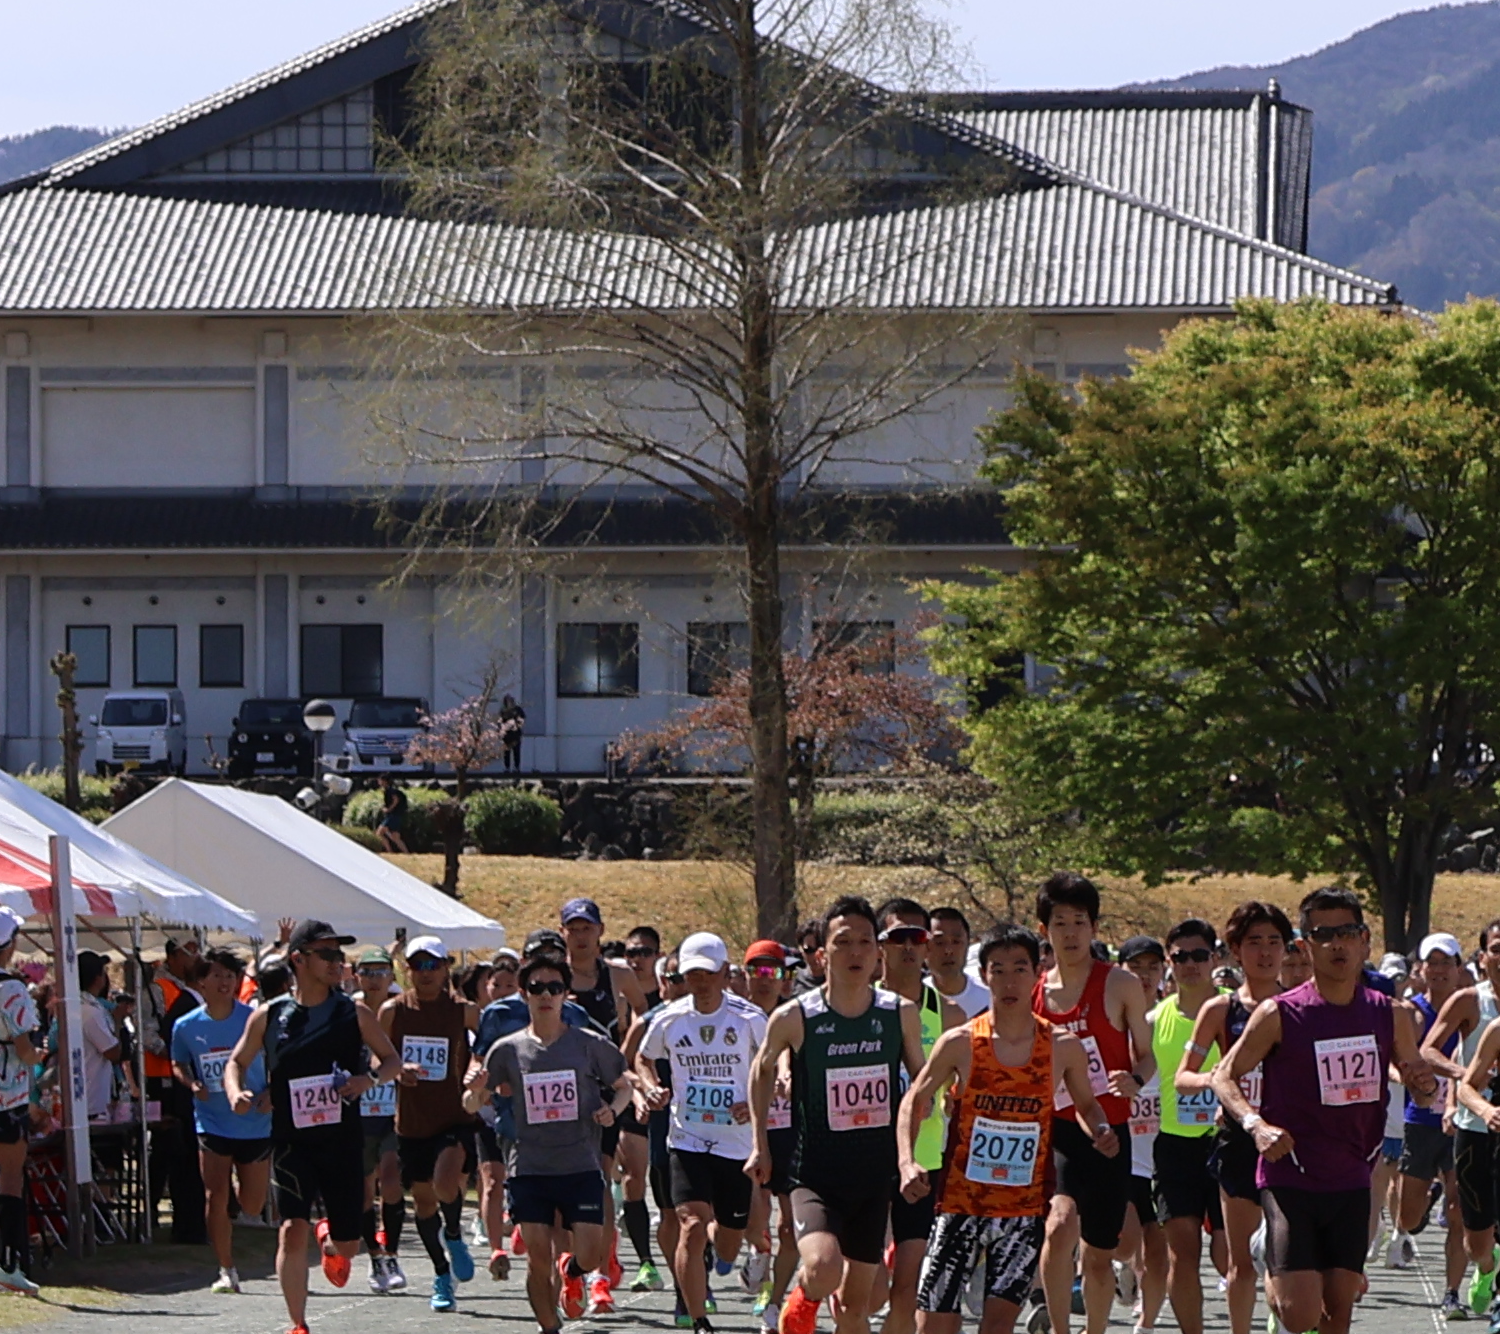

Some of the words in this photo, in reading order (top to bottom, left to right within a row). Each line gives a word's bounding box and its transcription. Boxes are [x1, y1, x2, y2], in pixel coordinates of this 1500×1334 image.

[404, 1046, 446, 1064] 2148
[828, 1043, 857, 1056] Green
[860, 1040, 882, 1054] Park
[676, 1052, 741, 1067] Emirates
[1322, 1051, 1376, 1081] 1127
[294, 1086, 340, 1111] 1240
[362, 1083, 396, 1102] 077
[527, 1082, 575, 1105] 1126
[686, 1086, 734, 1107] 2108
[831, 1080, 888, 1107] 1040
[974, 1095, 1043, 1114] UNITED
[972, 1133, 1035, 1162] 2078
